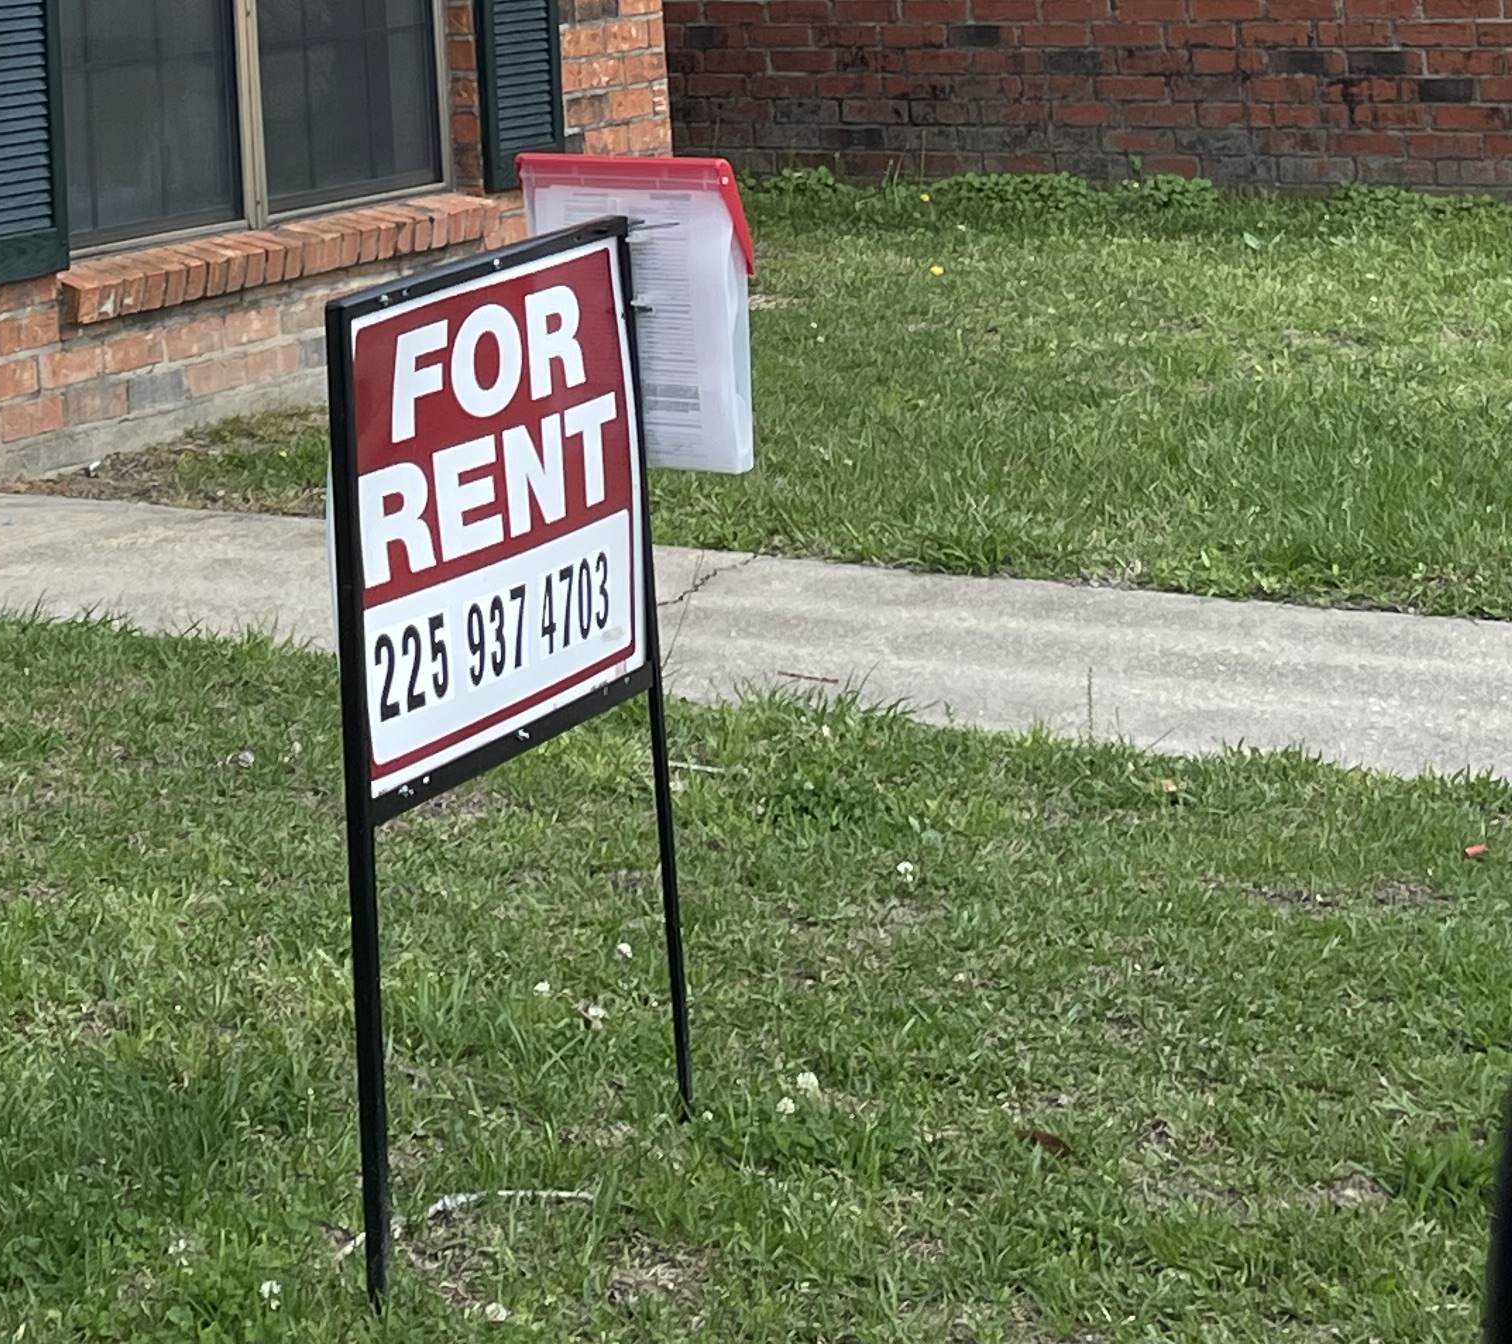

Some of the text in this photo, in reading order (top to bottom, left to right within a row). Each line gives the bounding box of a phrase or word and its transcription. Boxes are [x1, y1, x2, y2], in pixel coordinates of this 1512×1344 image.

[392, 285, 586, 443] FOR
[358, 392, 617, 589] RENT
[374, 551, 610, 722] 225 937 4703
